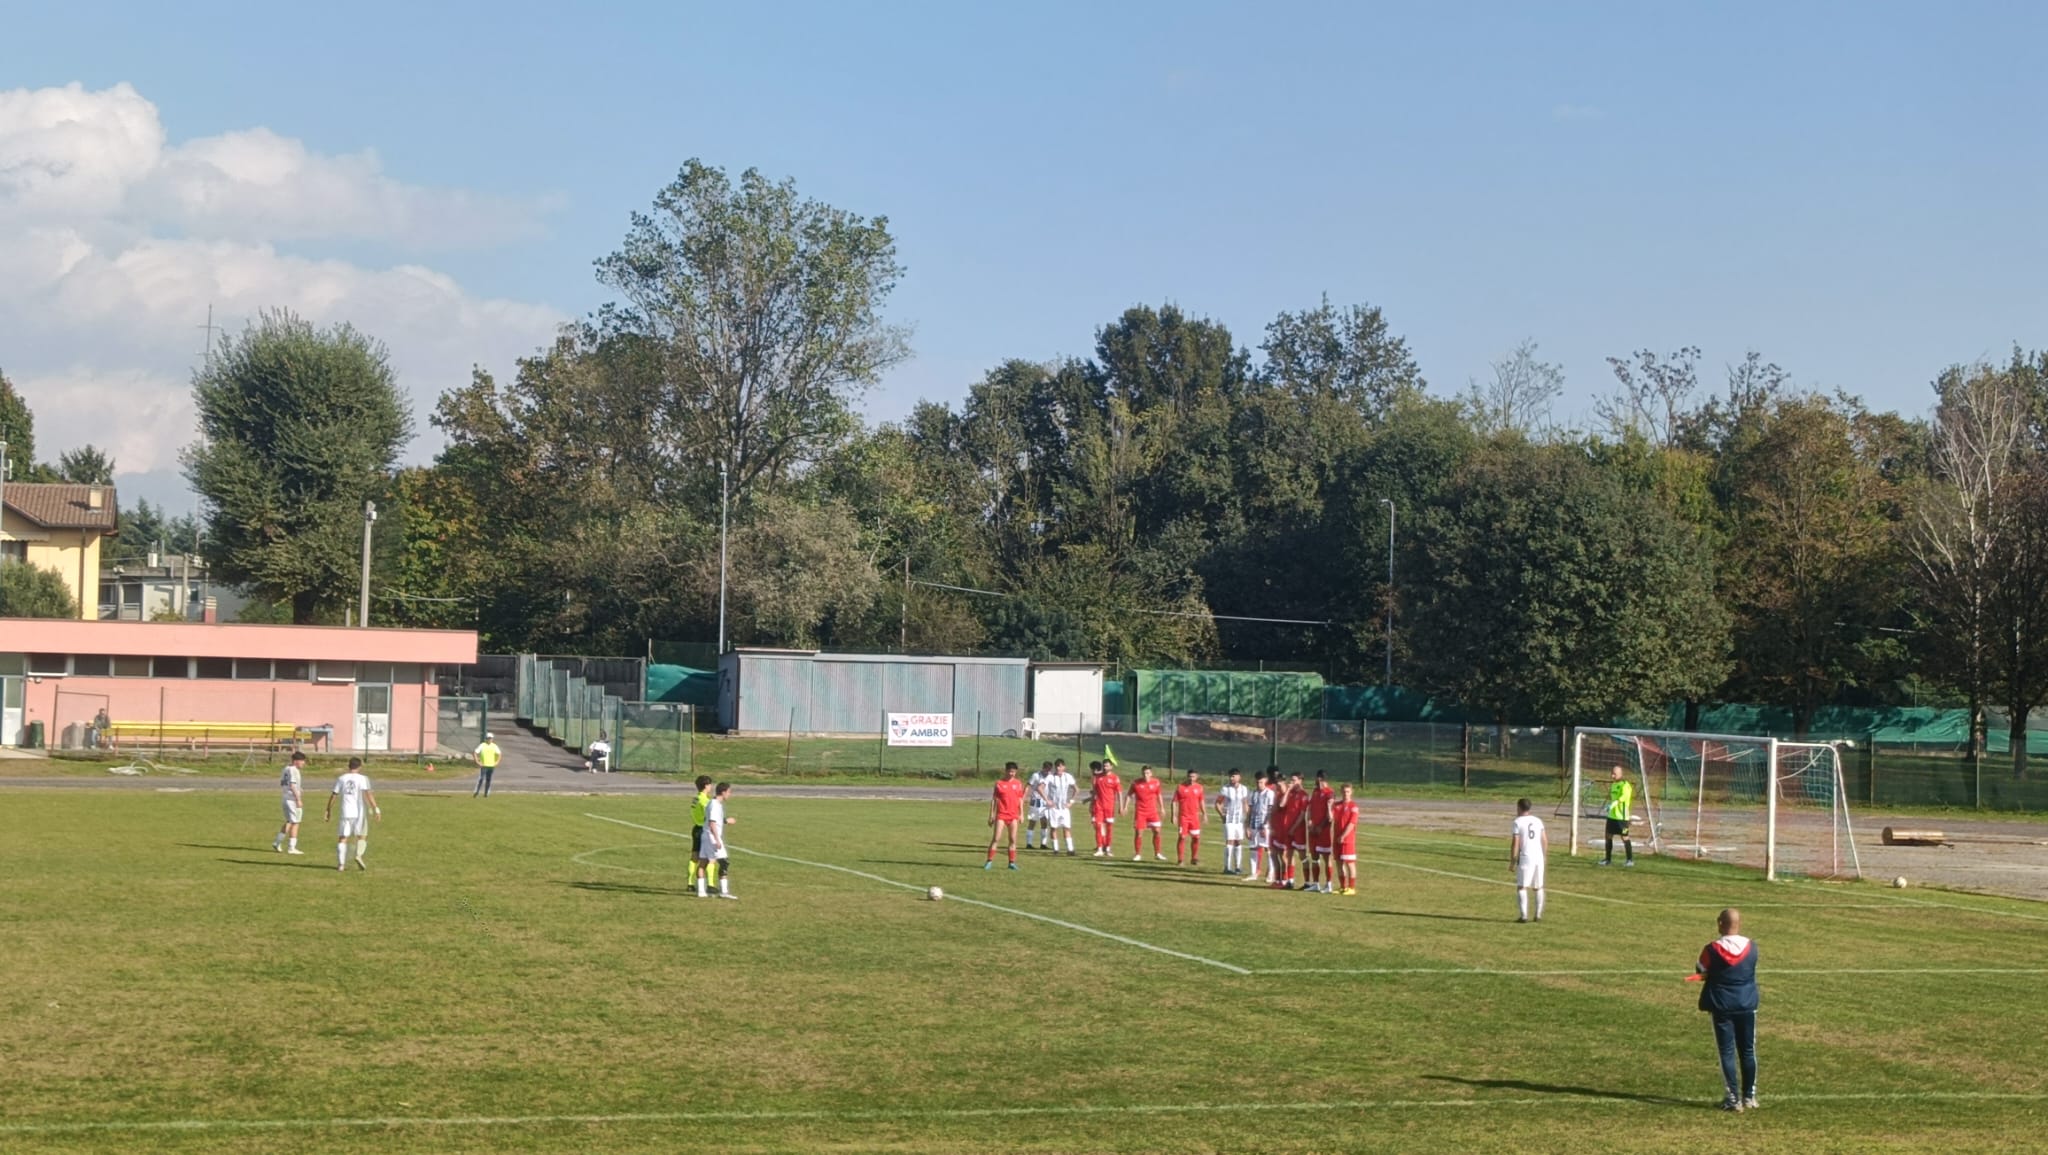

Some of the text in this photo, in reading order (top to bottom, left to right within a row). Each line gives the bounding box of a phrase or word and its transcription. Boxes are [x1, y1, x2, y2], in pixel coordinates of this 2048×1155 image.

[910, 715, 949, 725] GRAZIE
[910, 728, 948, 737] AMBRO
[1527, 822, 1536, 840] 6
